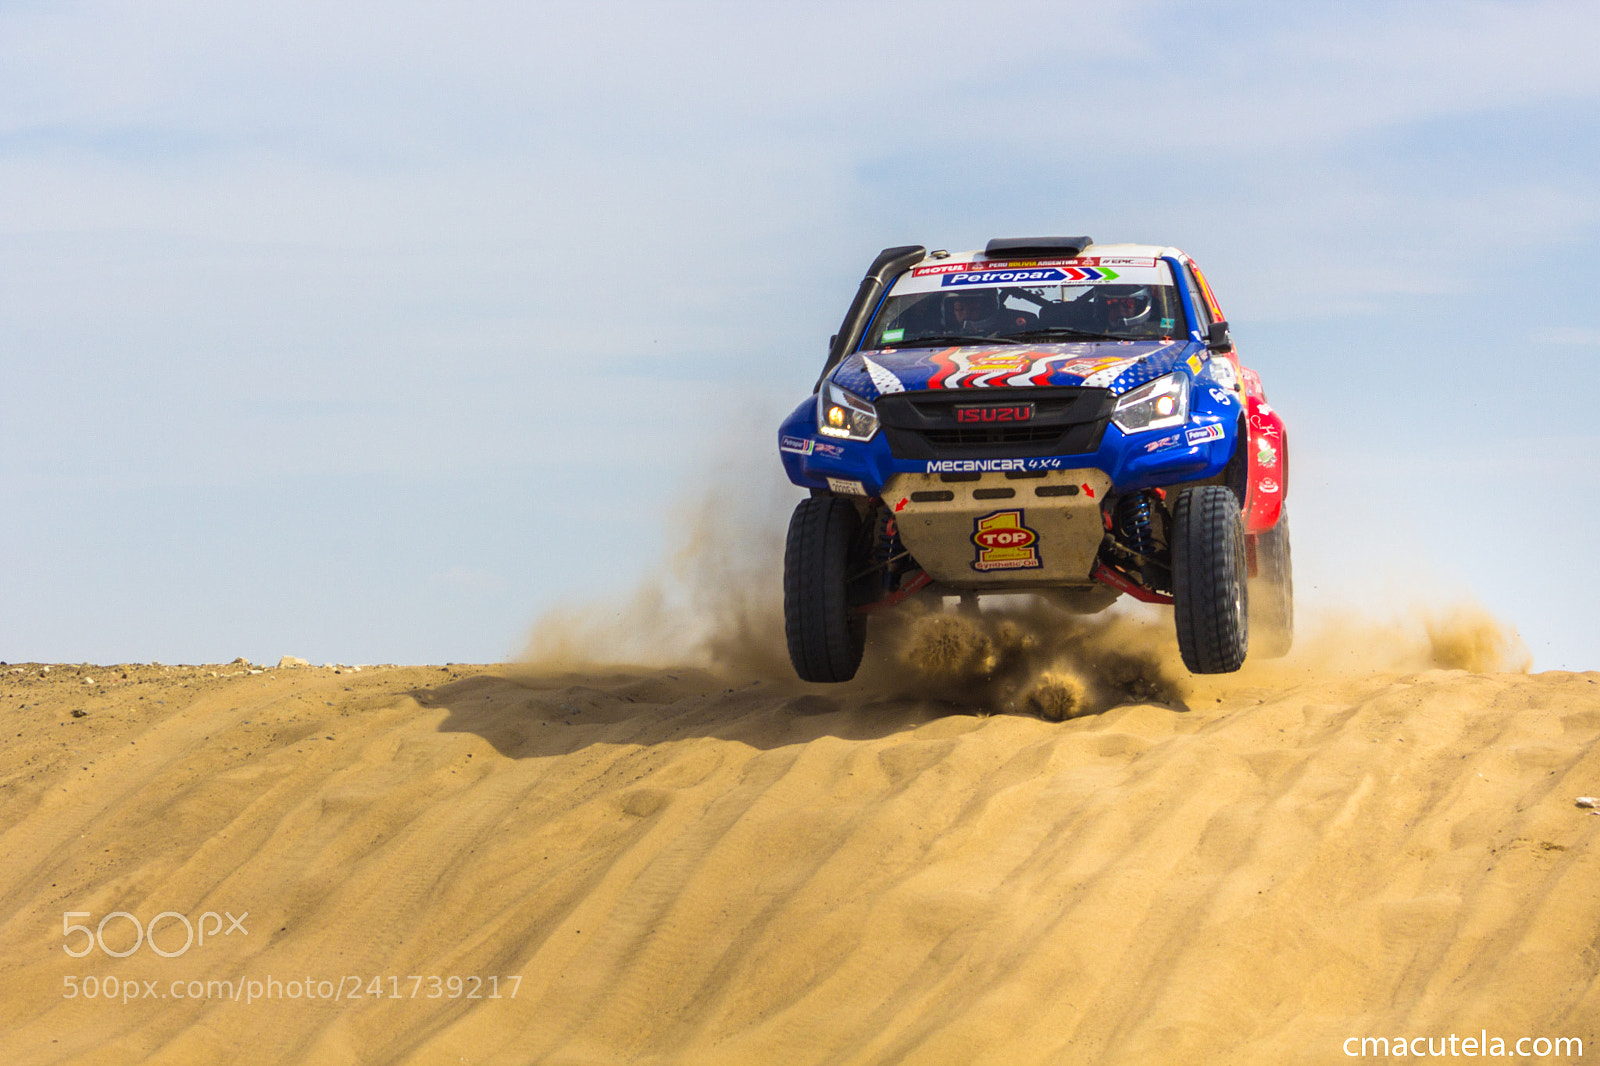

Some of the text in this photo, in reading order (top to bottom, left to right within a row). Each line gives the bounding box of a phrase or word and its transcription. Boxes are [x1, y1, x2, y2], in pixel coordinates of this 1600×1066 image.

[917, 265, 964, 275] MOTUL
[950, 270, 1055, 284] Petropar
[958, 407, 1030, 422] ISUZU
[983, 532, 1027, 544] TOP
